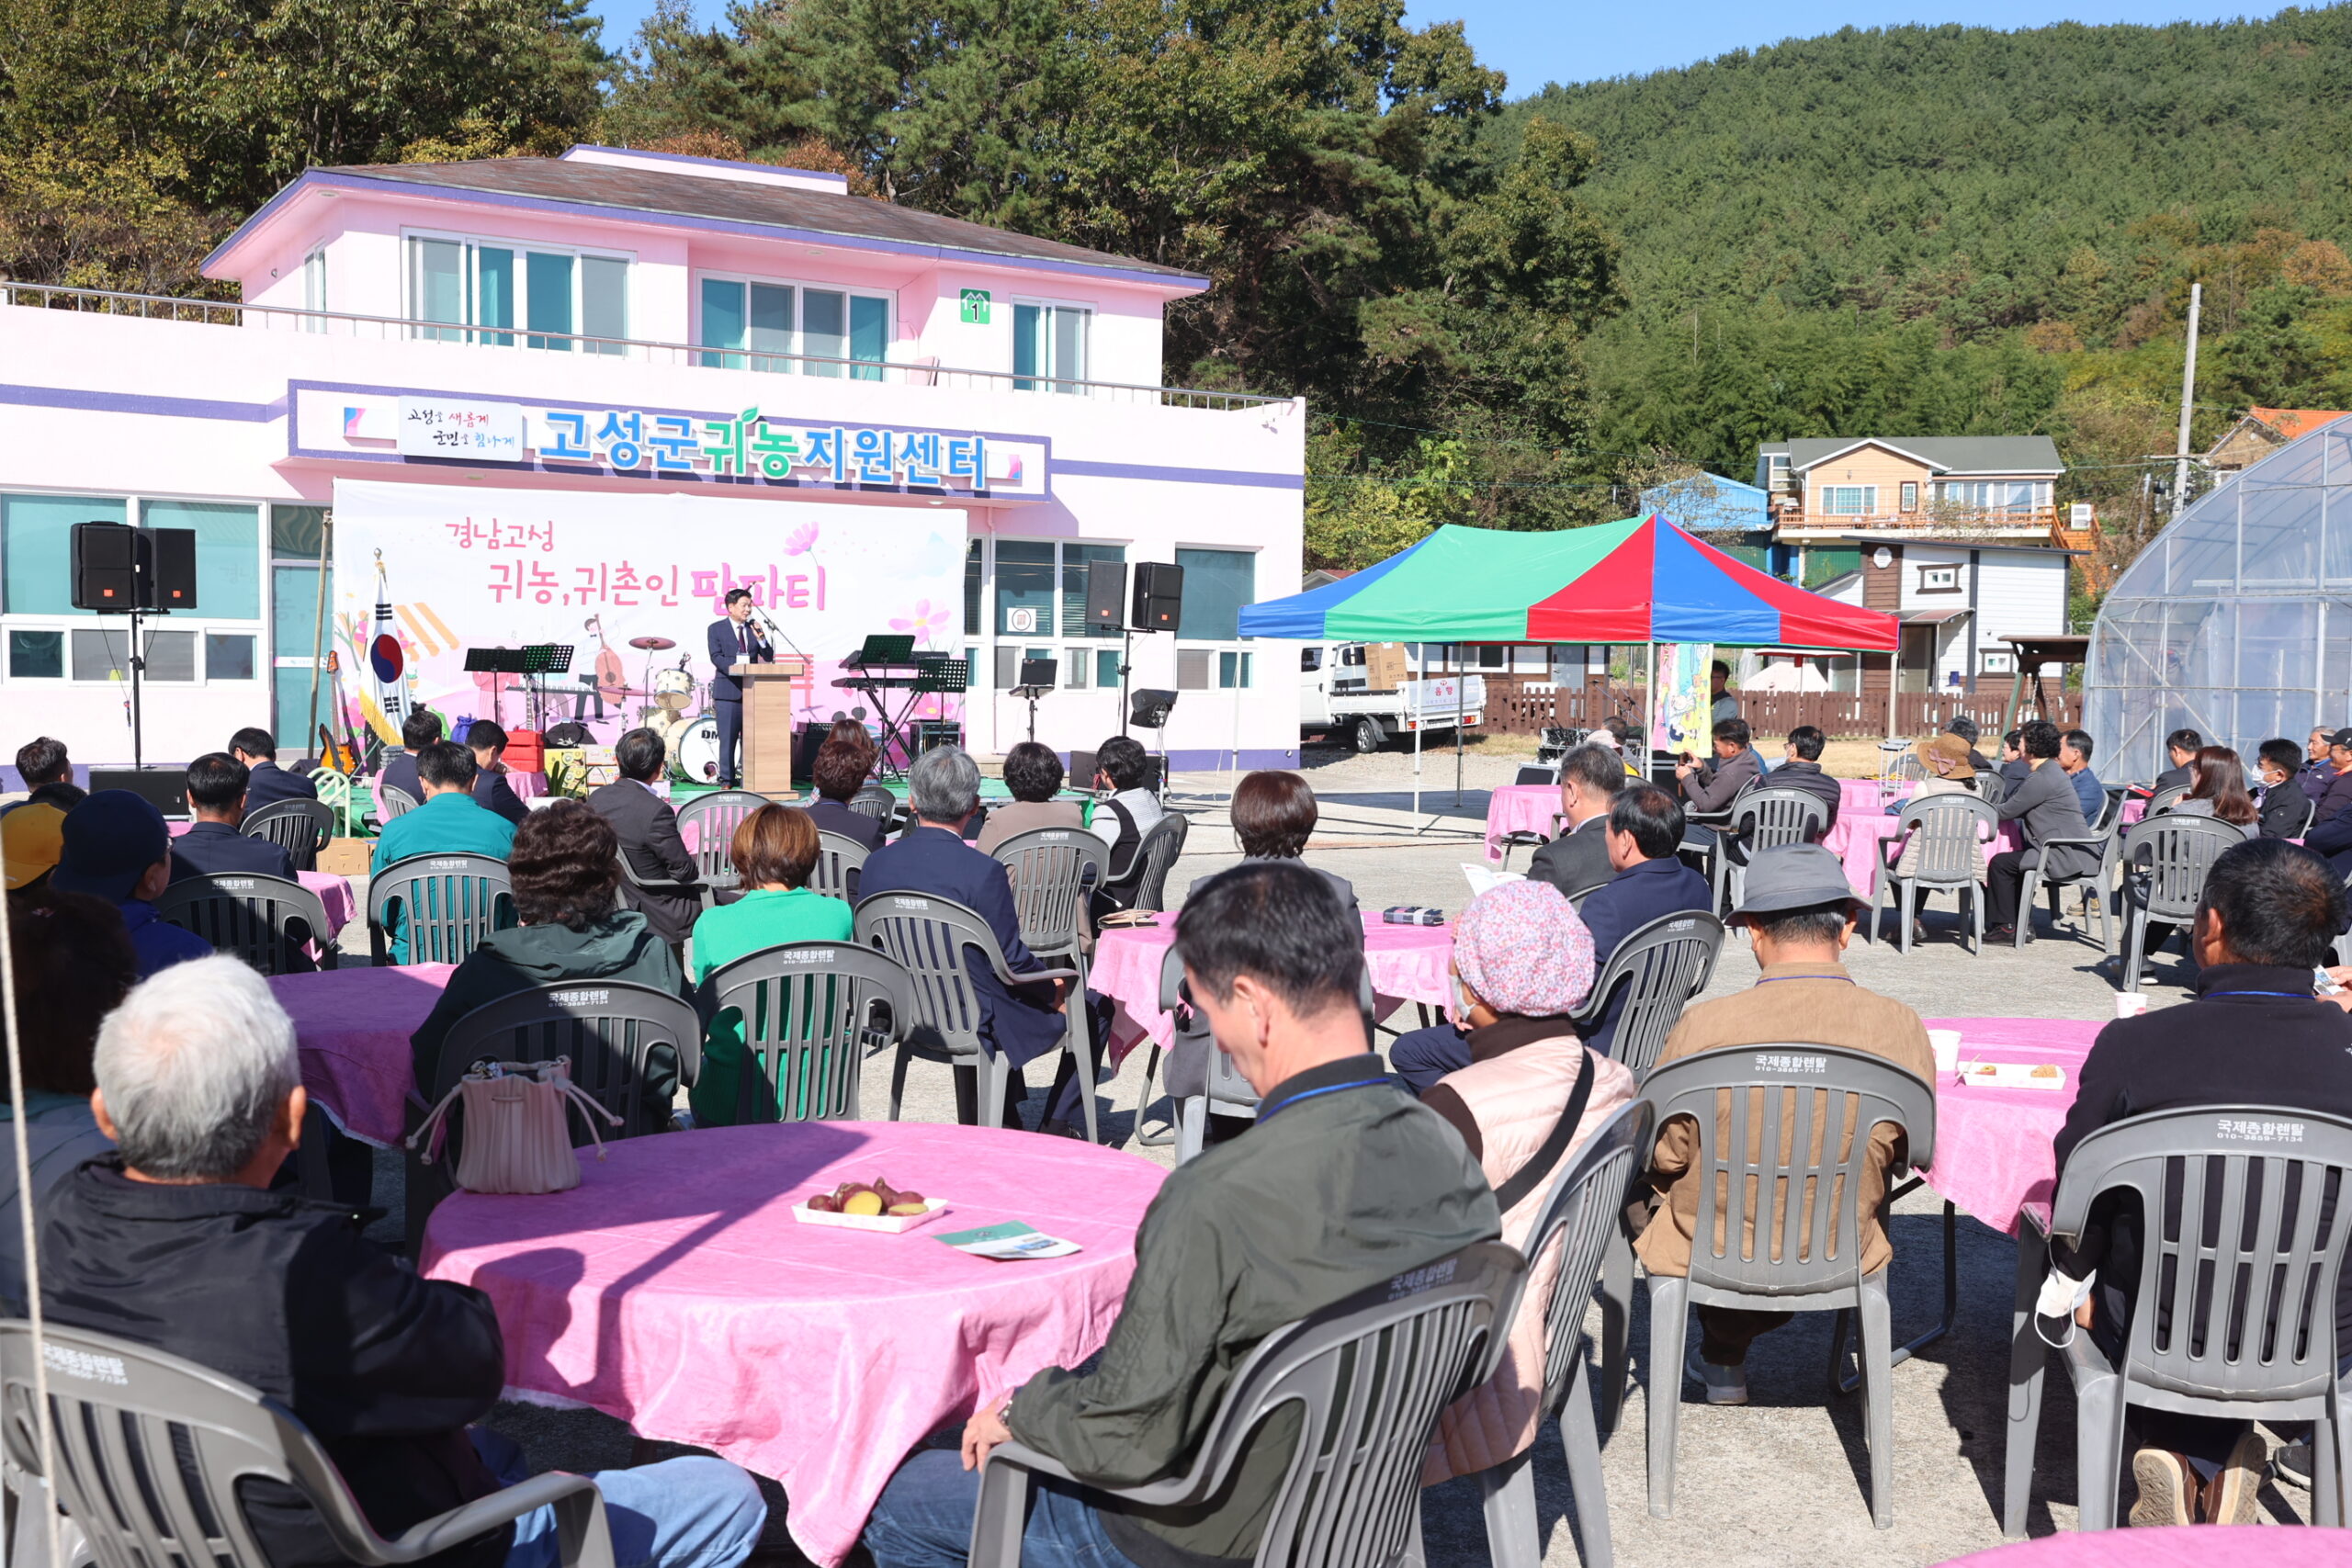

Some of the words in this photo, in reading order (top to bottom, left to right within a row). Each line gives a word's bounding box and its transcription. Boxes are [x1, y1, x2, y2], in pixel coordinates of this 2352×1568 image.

[445, 516, 554, 552] 경남고성
[784, 950, 835, 960] 국제종합렌탈
[548, 990, 609, 1002] 국제종합렌탈
[1755, 1055, 1827, 1067] 국제종합렌탈
[2217, 1119, 2305, 1136] 국제종합렌탈
